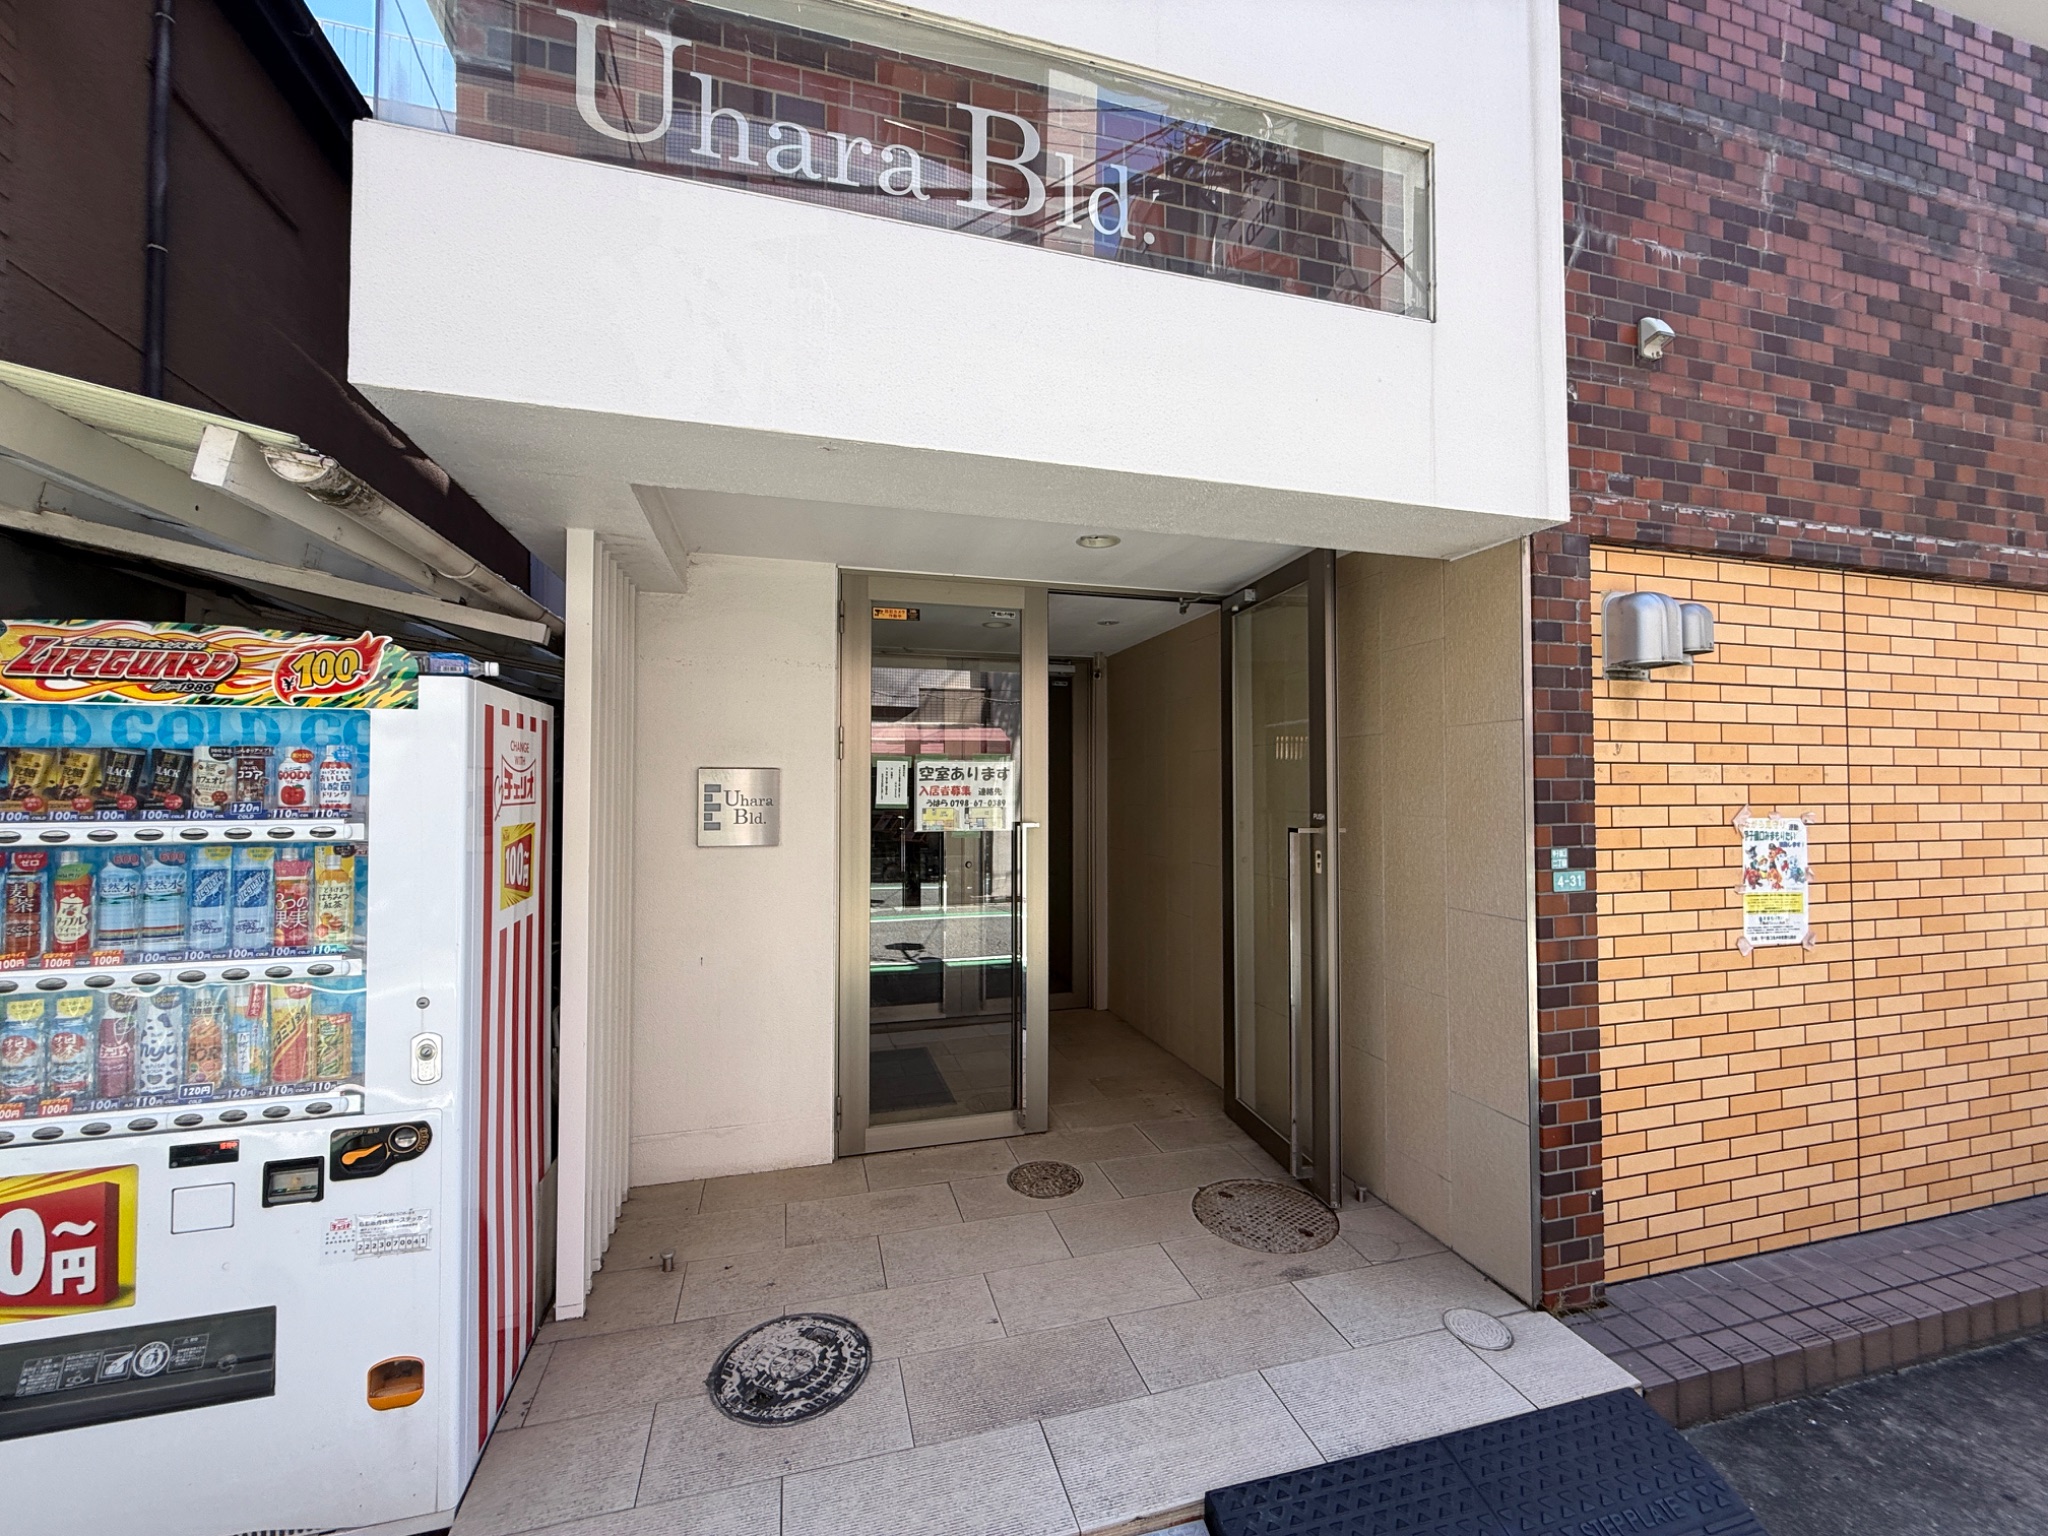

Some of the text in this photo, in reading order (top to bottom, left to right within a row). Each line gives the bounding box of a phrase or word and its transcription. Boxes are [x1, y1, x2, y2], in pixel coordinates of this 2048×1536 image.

[556, 8, 1156, 245] Uhara Bld.
[3, 636, 241, 681] LIFEGUARD
[178, 682, 214, 692] 1986
[0, 708, 92, 748] LD
[111, 709, 282, 749] COLD
[511, 740, 530, 753] CHANGE
[514, 756, 526, 766] WITH
[237, 770, 264, 780] ココア
[278, 770, 313, 780] GOODY
[918, 766, 1010, 782] 空室あります
[320, 782, 351, 792] 乳酸菌
[504, 767, 534, 800] チェリオ
[918, 786, 1003, 796] 入居者募集 連絡先
[723, 790, 774, 807] Uhara
[926, 799, 949, 807] うはら
[231, 803, 260, 813] 120円
[314, 808, 339, 818] 110円
[50, 811, 78, 821] 100円
[96, 811, 125, 821] 100円
[141, 810, 170, 820] 100円
[186, 810, 213, 819] 100円
[273, 809, 298, 819] 110円
[733, 808, 767, 825] Bld.
[113, 854, 140, 864] 600
[159, 852, 186, 861] 600
[143, 880, 183, 891] 天然水
[1557, 874, 1582, 888] 4-31
[10, 884, 35, 914] 麦茶
[275, 893, 309, 910] 3つの
[318, 893, 350, 902] はちみつ
[323, 901, 343, 909] 紅茶
[56, 916, 87, 926] アップル
[275, 910, 309, 928] 果実
[228, 949, 254, 958] 100円
[270, 947, 296, 956] 100円
[312, 945, 337, 954] 110円
[94, 955, 121, 966] 100円
[139, 952, 166, 963] 100円
[184, 951, 210, 960] 100円
[44, 958, 71, 968] 100円
[183, 1085, 211, 1096] 120円
[268, 1085, 293, 1095] 110円
[312, 1081, 337, 1091] 110円
[227, 1088, 254, 1098] 120円
[90, 1100, 119, 1110] 100円
[135, 1096, 164, 1107] 110円
[41, 1104, 68, 1115] 100円
[357, 1237, 426, 1251] 2223070041
[1621, 1496, 1688, 1534] PLATE
